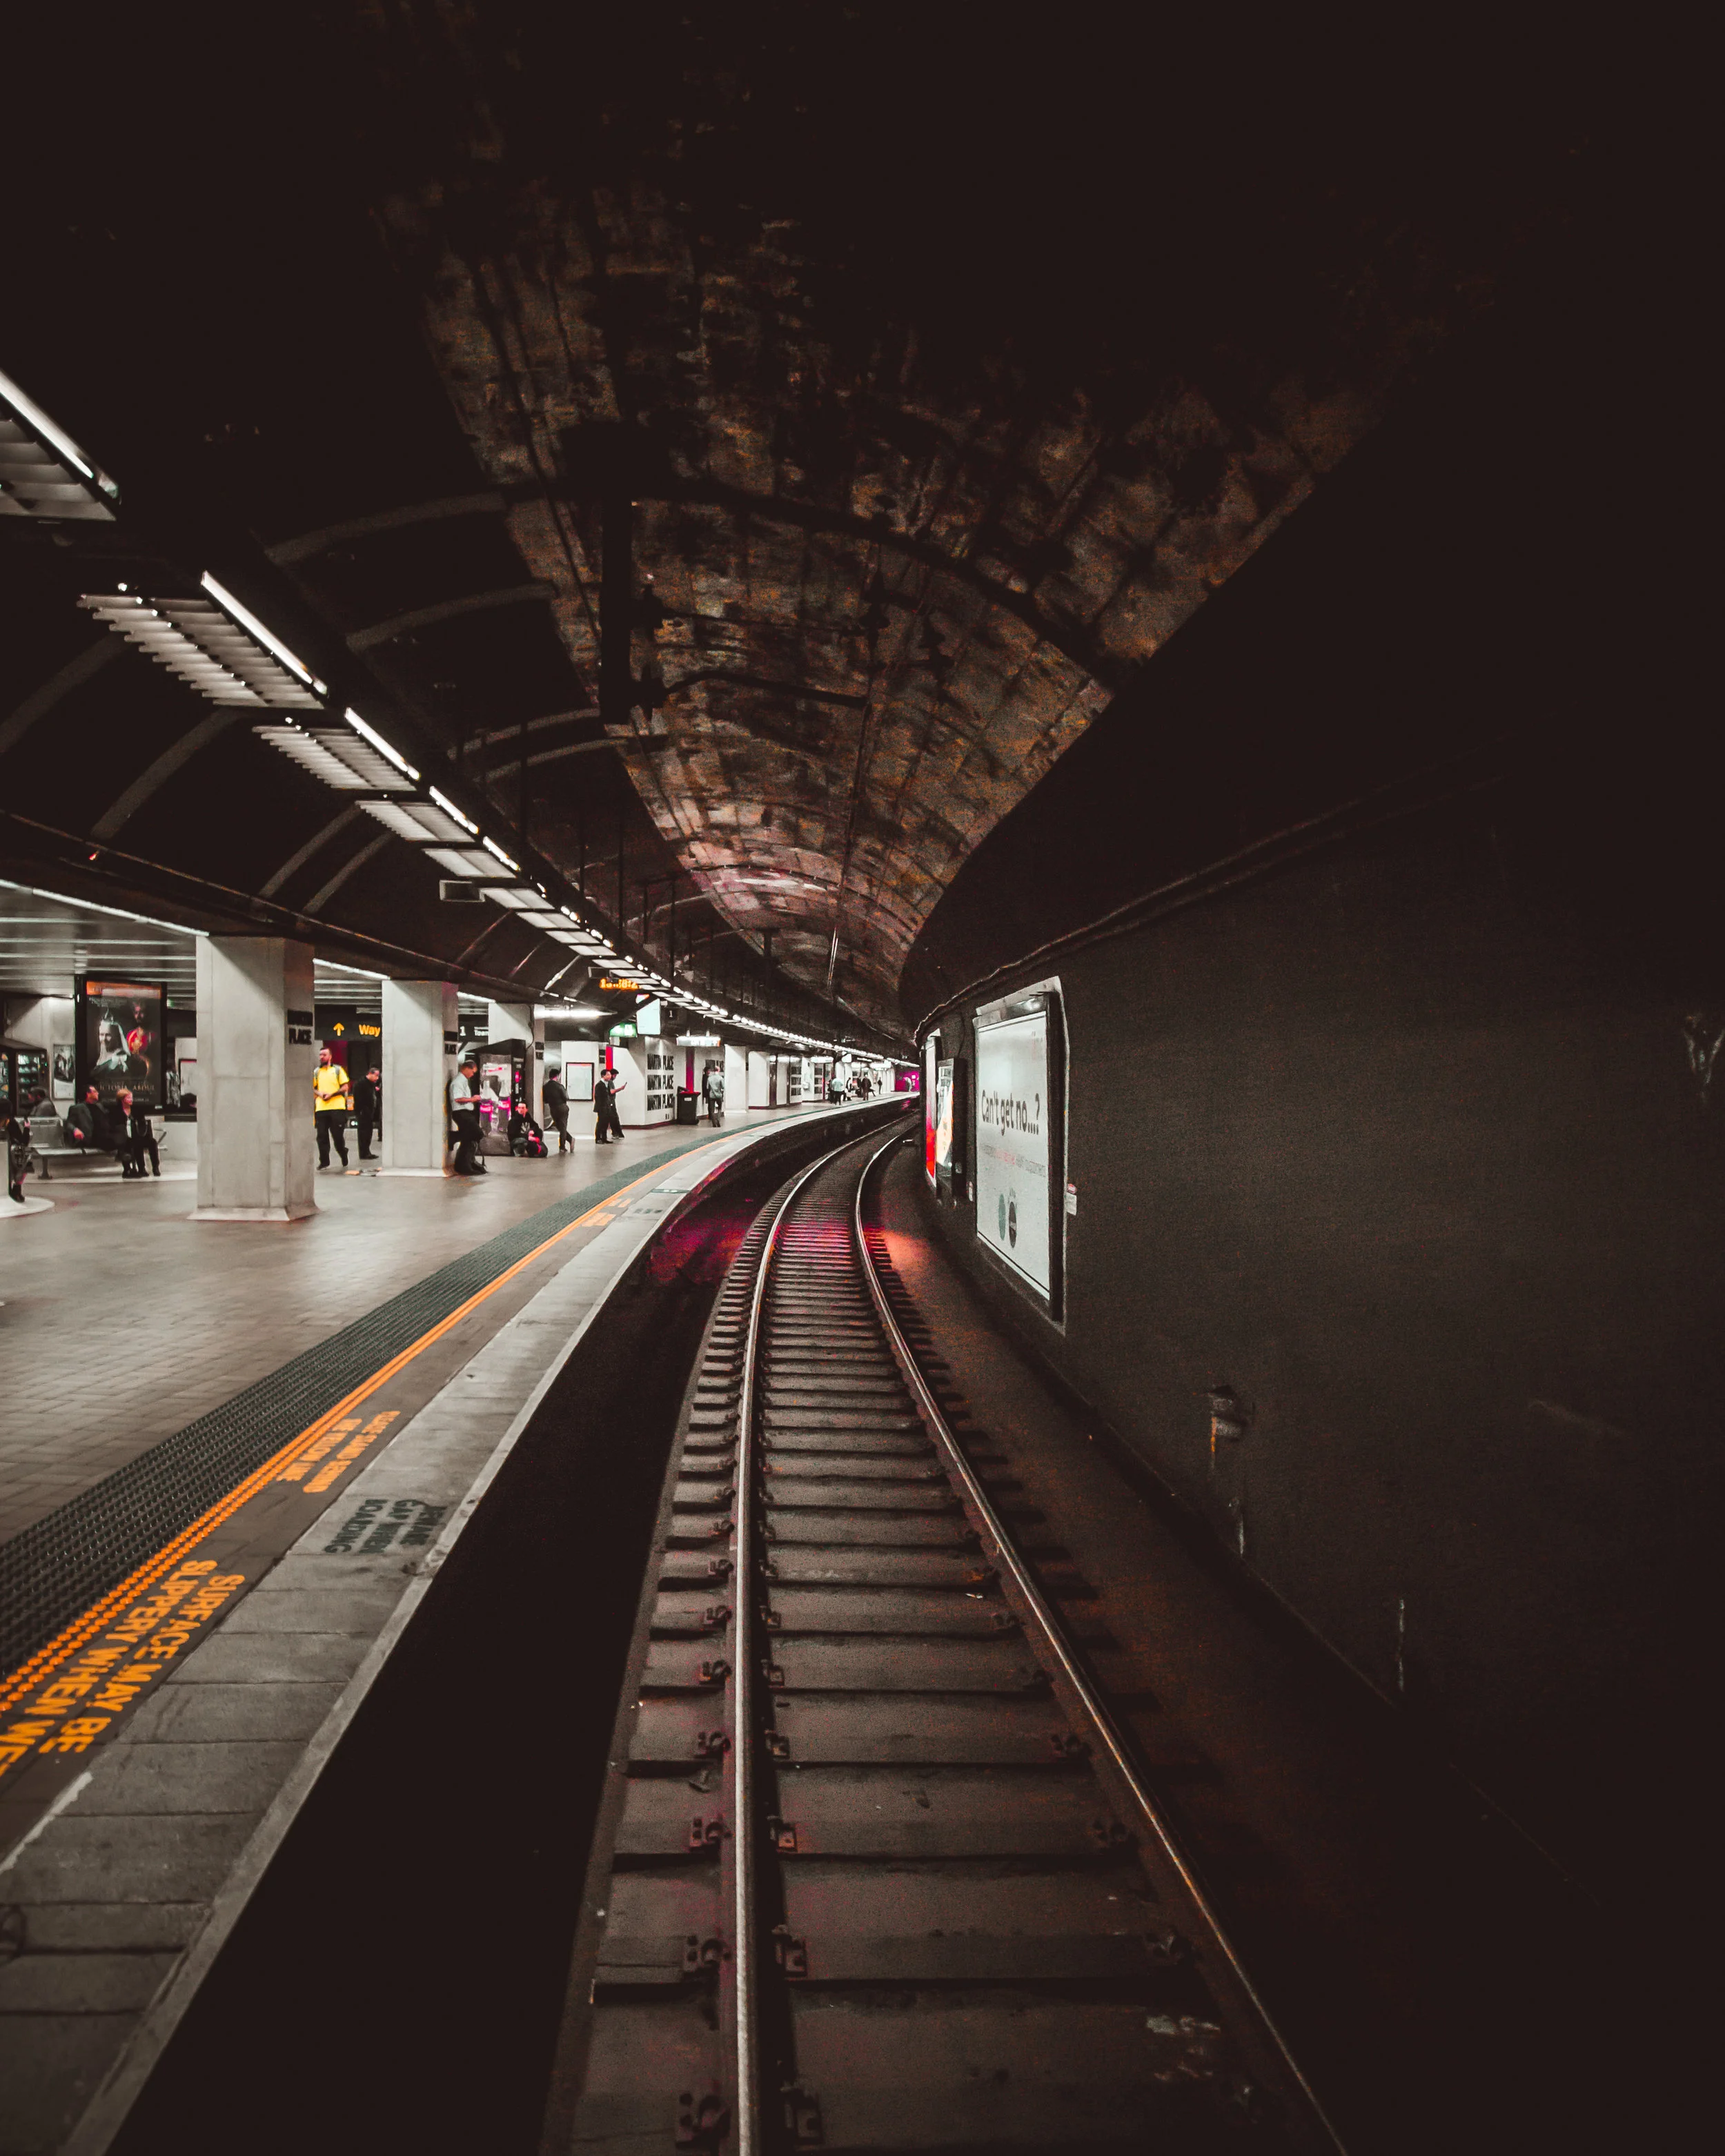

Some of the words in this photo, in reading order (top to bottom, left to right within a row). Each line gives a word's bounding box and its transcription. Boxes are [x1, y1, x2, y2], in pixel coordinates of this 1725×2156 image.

[359, 1025, 380, 1037] Way
[460, 1026, 466, 1036] 1
[982, 1090, 998, 1125] Can't
[1000, 1093, 1014, 1136] get
[323, 1499, 388, 1553] BOARDING
[105, 1560, 218, 1643] SLIPPERY
[134, 1574, 245, 1659] SURFACE
[24, 1645, 130, 1715] WHEN
[86, 1663, 162, 1712] MAY
[39, 1717, 111, 1753] BE
